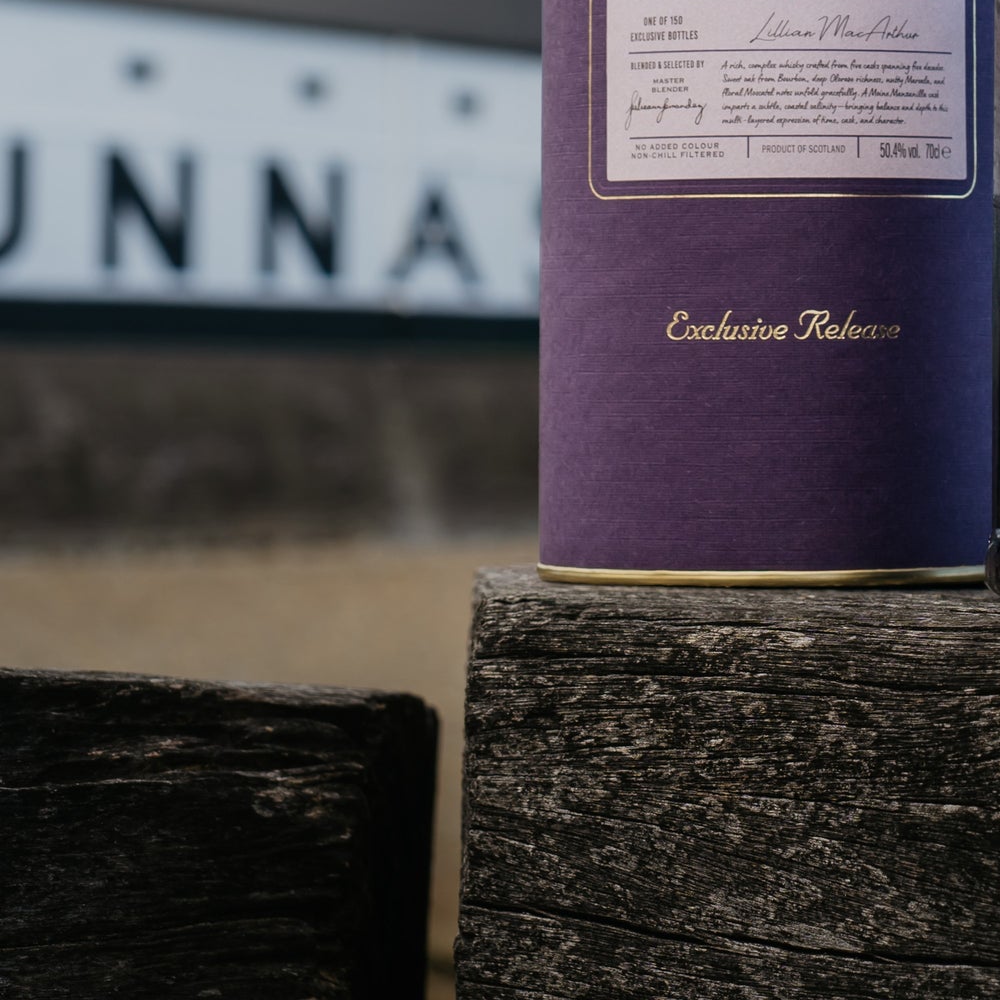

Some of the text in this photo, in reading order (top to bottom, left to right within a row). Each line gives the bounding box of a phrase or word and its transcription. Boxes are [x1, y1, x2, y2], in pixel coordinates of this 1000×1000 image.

[643, 15, 683, 26] ONE OF 150
[749, 11, 815, 44] Lillian
[630, 30, 699, 42] EXCLUSIVE BOTTLES
[630, 61, 656, 70] BLENDED
[663, 60, 695, 69] SELECTED
[696, 60, 704, 68] BY
[761, 144, 846, 154] PRODUCT OF SCOTLAND
[0, 137, 541, 284] NNA
[666, 309, 901, 341] Exclusive Release
